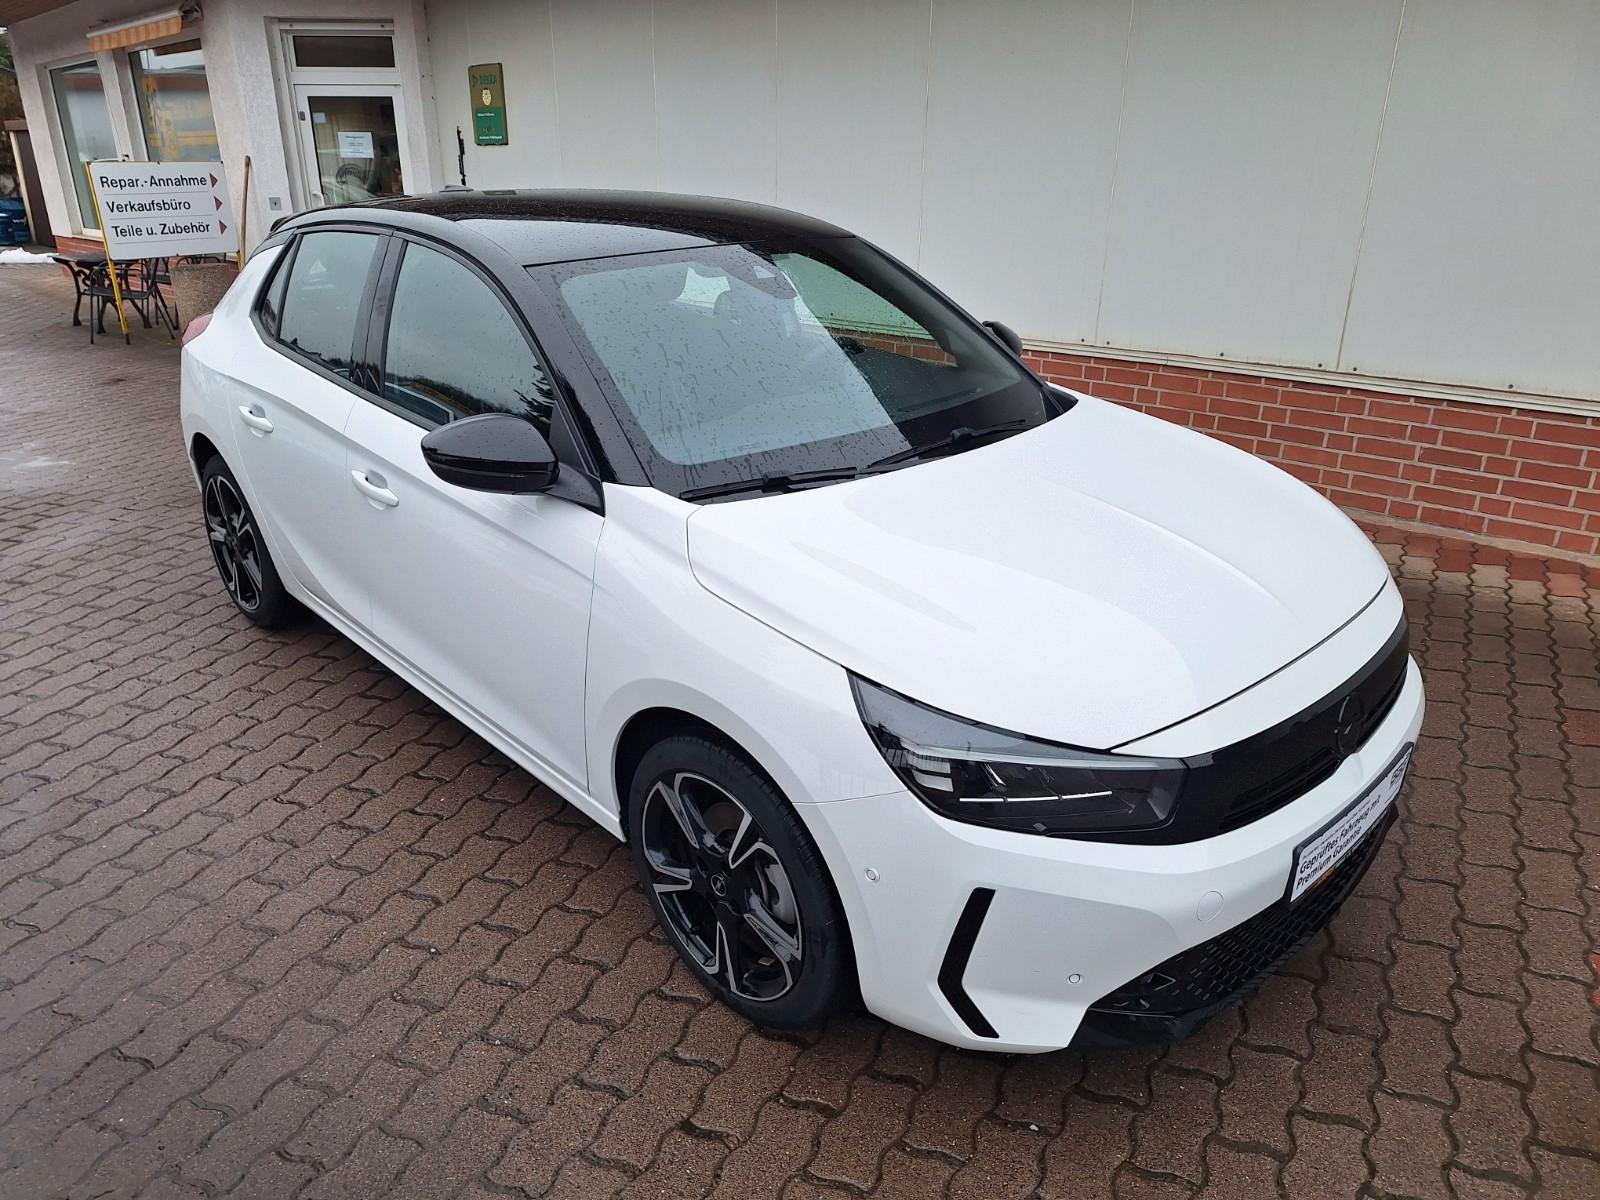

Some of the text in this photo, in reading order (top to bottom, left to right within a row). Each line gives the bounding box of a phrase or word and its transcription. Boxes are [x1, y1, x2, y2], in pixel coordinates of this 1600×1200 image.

[99, 174, 207, 190] Repar.-Annahme
[105, 198, 191, 213] Verkaufsbüro
[112, 221, 210, 238] Teile u. Zubehör
[1300, 836, 1340, 874] Geprüftes
[1340, 806, 1370, 838] Fahrzeug
[1296, 855, 1332, 890] Premium
[1332, 825, 1362, 858] Garantie
